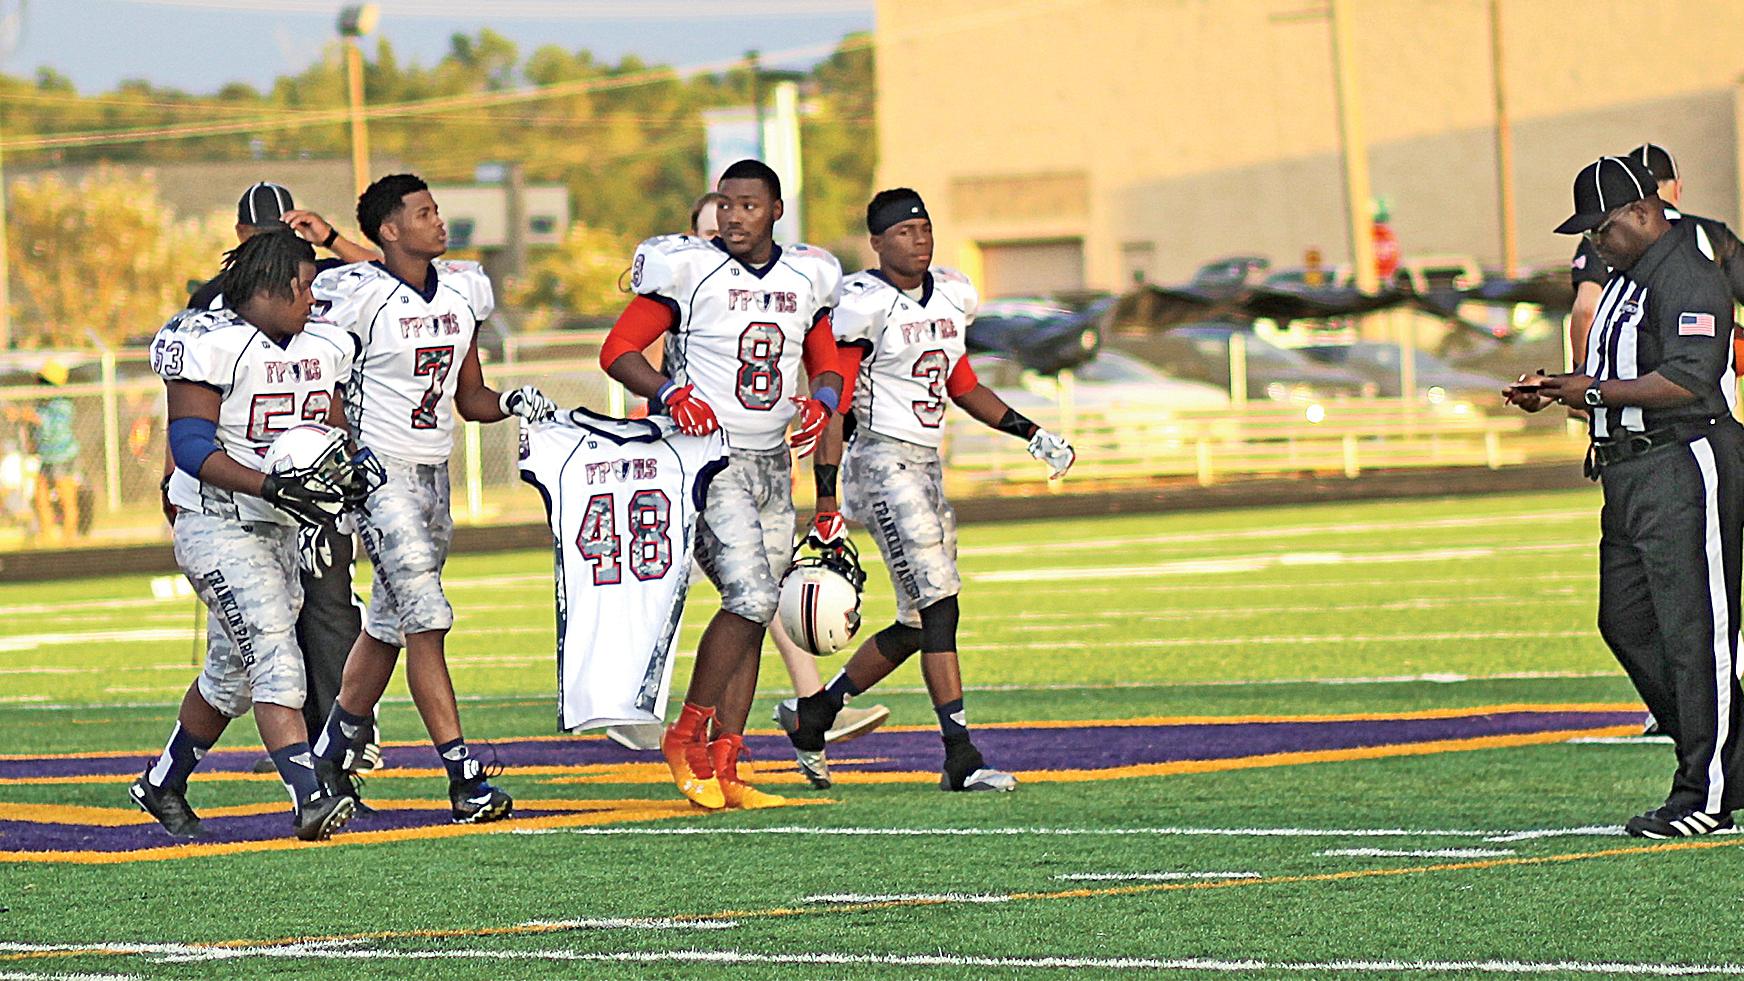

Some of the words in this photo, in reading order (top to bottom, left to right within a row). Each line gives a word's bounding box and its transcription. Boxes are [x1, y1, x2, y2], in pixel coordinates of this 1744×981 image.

[631, 253, 645, 288] 8
[153, 339, 184, 376] 53
[411, 345, 455, 429] 7
[735, 322, 785, 411] 8
[912, 349, 949, 428] 3
[355, 515, 381, 567] RANKLIN
[575, 489, 672, 587] 48
[873, 501, 904, 560] FRANKLIN
[893, 560, 920, 600] PARISH
[203, 569, 244, 628] FRANKLIN
